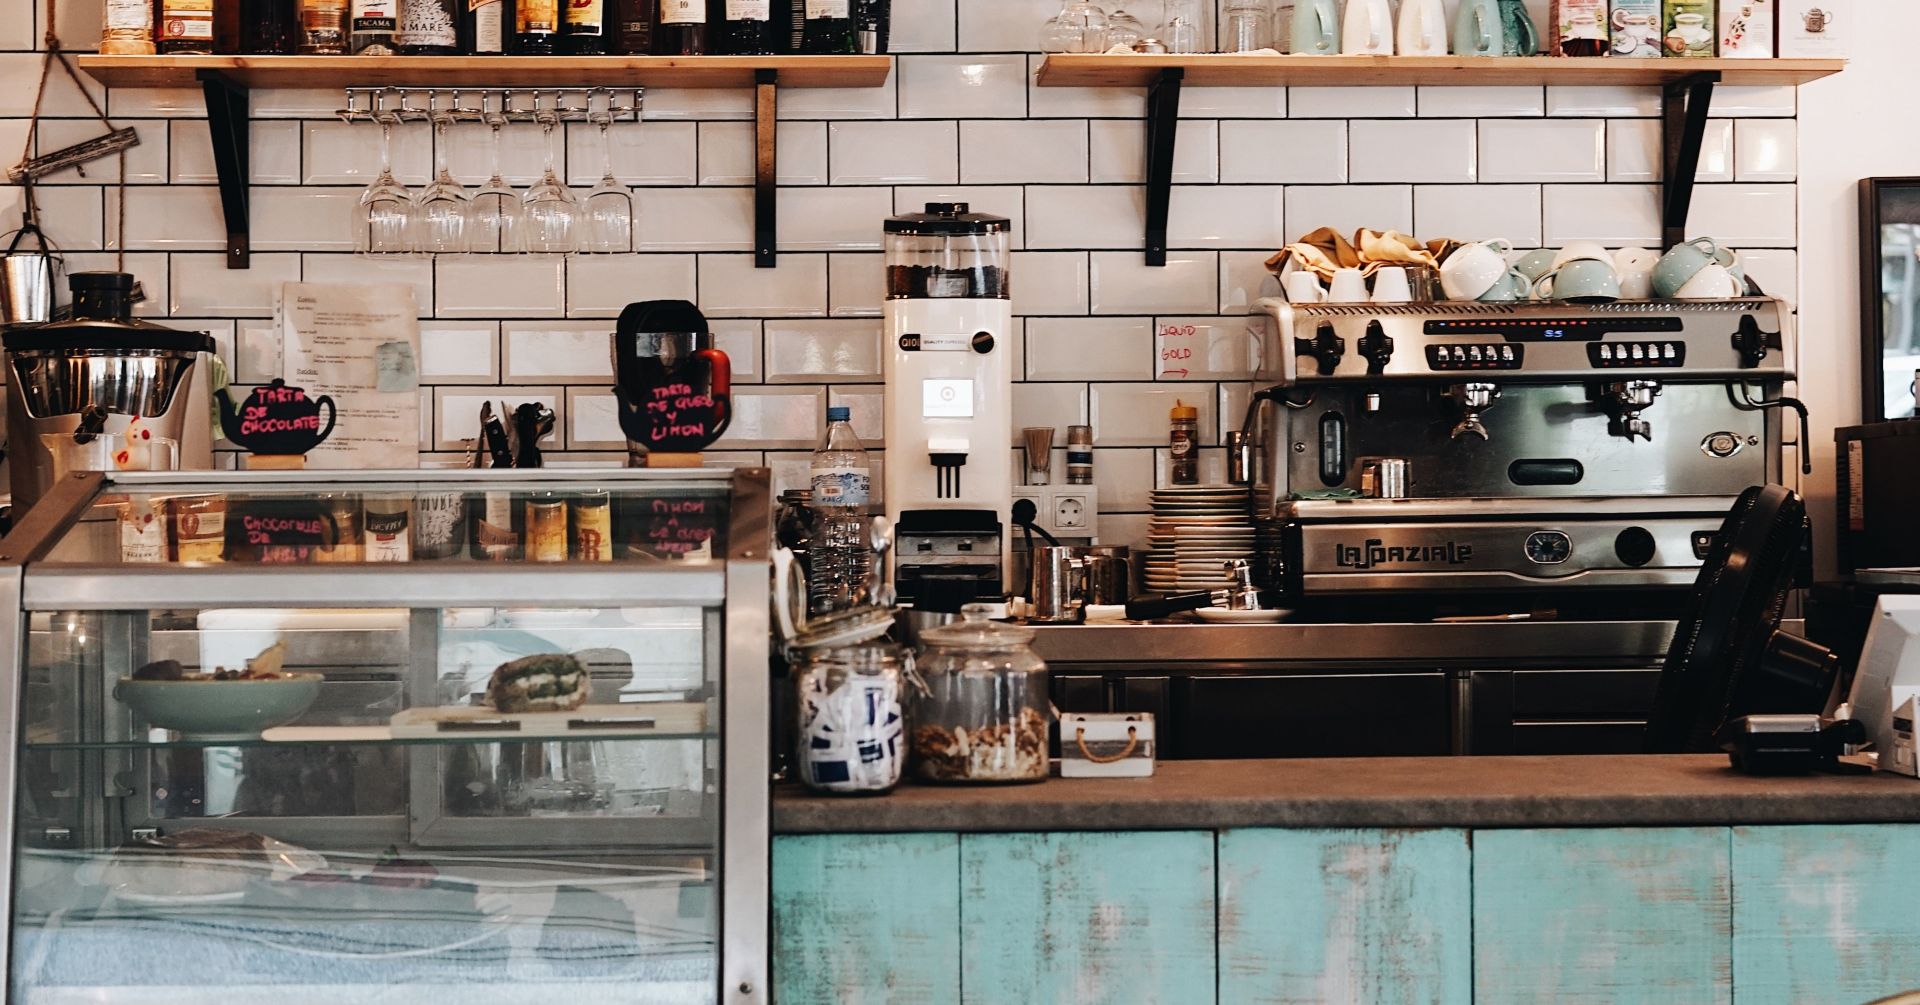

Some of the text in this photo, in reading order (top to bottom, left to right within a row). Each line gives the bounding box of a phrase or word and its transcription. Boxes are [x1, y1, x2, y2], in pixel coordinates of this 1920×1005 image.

[358, 20, 391, 28] TACAMA
[408, 23, 444, 32] MARE
[1159, 324, 1196, 336] LIQUID
[1162, 348, 1192, 361] GOLD
[256, 387, 305, 405] TARTA
[652, 384, 692, 399] TARTA
[244, 405, 267, 420] DE
[666, 411, 678, 424] Y
[241, 415, 319, 435] CHOCOLATE
